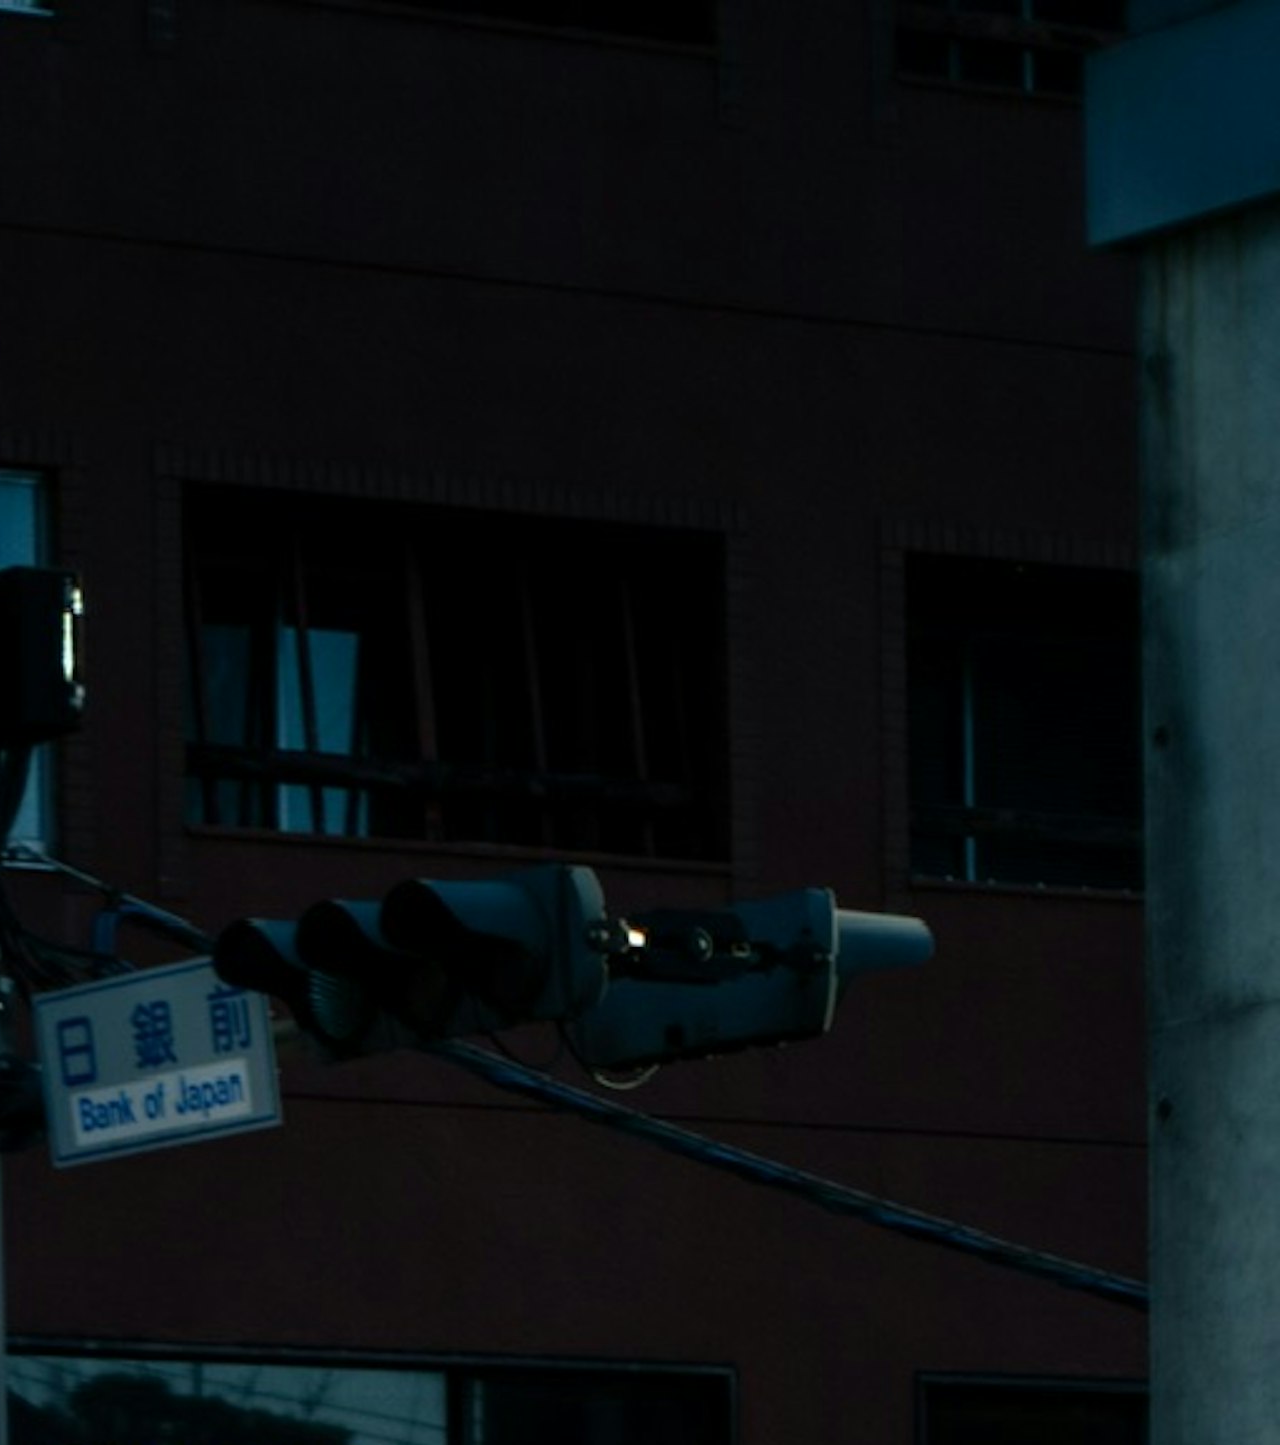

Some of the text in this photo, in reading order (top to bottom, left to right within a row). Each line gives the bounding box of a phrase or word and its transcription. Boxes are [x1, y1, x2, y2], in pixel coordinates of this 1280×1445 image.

[58, 987, 250, 1085] 日銀前
[80, 1075, 241, 1130] Bank of Japan
